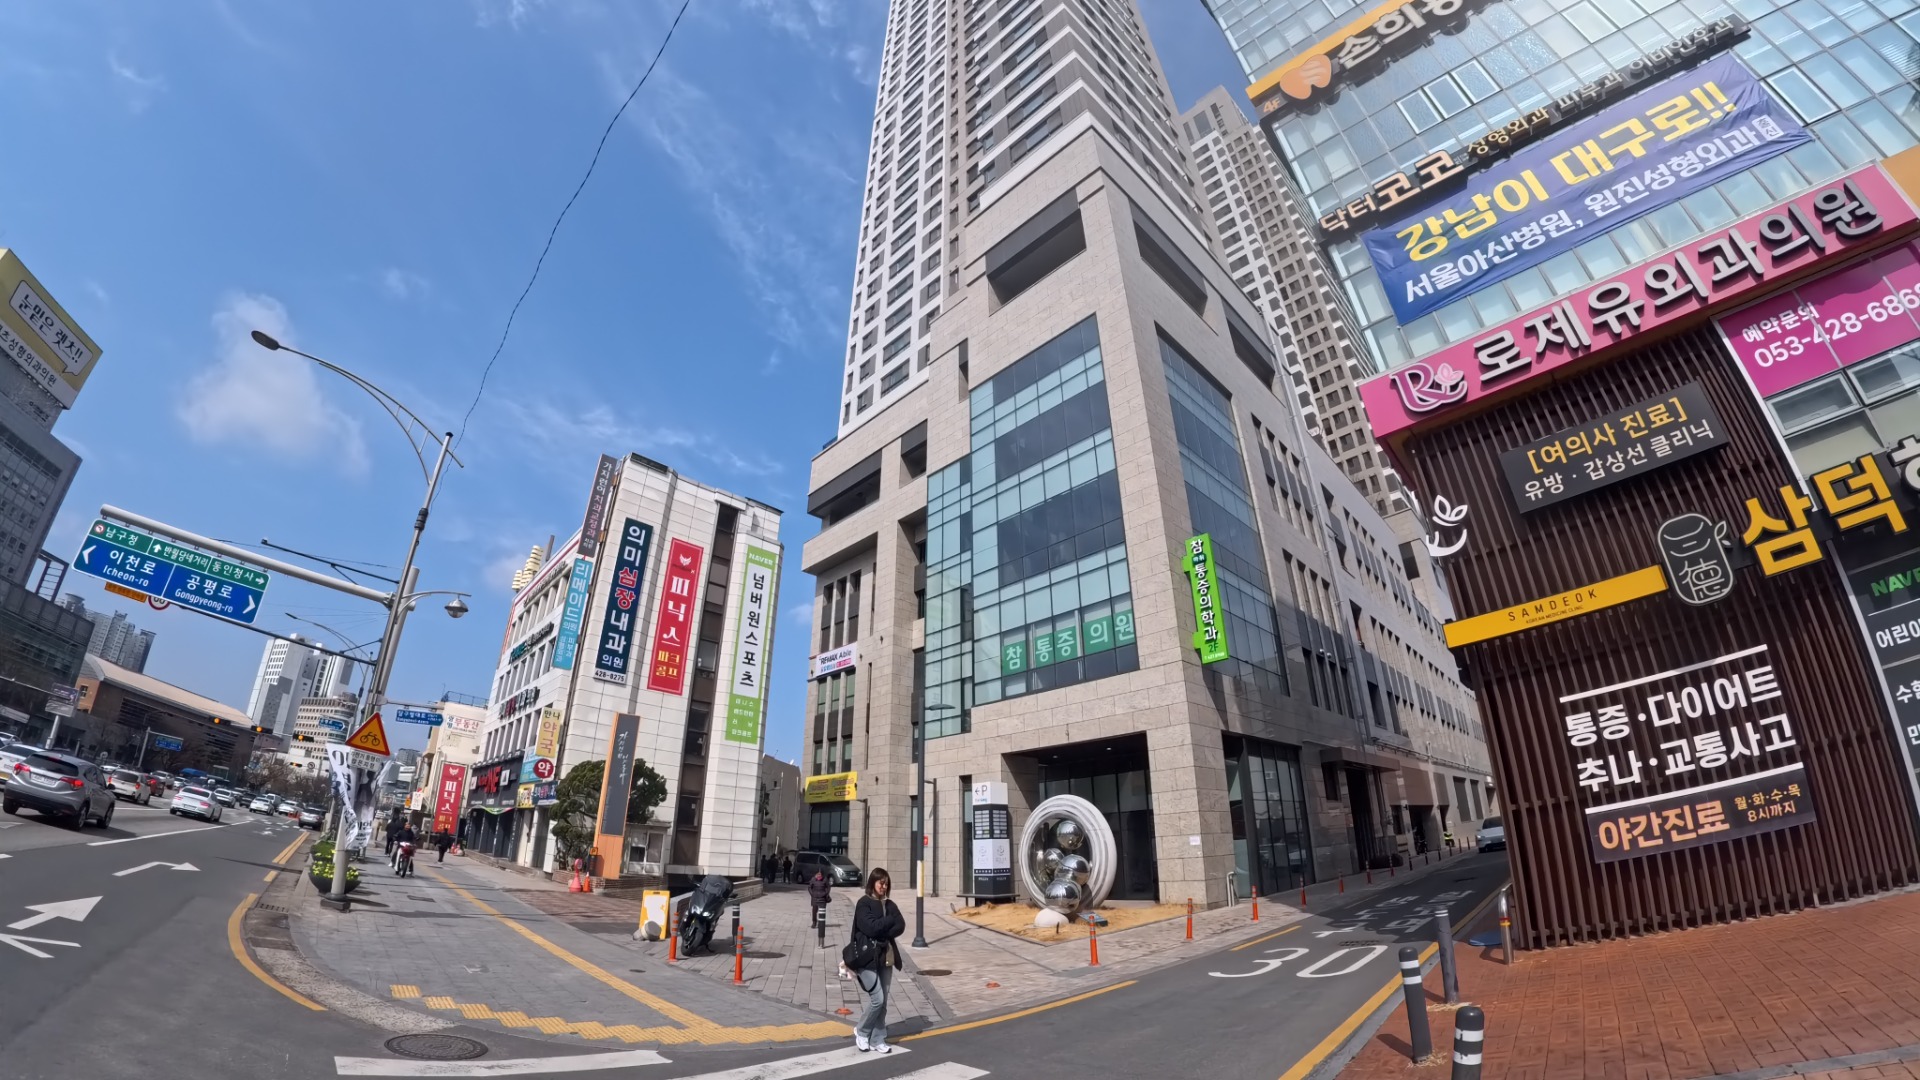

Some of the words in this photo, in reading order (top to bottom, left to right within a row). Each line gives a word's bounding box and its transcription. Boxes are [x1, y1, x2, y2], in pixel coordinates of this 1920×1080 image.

[1263, 97, 1280, 114] 4F
[1318, 150, 1465, 233] 닥터코코
[1465, 106, 1551, 156] 성형외과
[1555, 71, 1624, 111] 피부과
[1628, 17, 1737, 74] 이비인후과
[1396, 169, 1550, 262] 강남이
[1549, 81, 1738, 186] 대구로!!
[1584, 126, 1760, 217] 원진성형외과
[1473, 177, 1884, 386] 로제유외과의원
[18, 294, 55, 337] 눈밑은
[1742, 302, 1820, 343] 예약문의
[1527, 422, 1618, 475] [여의사
[1620, 396, 1688, 439] 진료]
[1524, 471, 1564, 501] 유방
[1583, 443, 1648, 481] 갑상선
[1650, 418, 1714, 458] 클리닉
[106, 526, 139, 546] 남구청
[1190, 538, 1203, 555] 참
[109, 549, 156, 576] 이천로
[164, 546, 208, 568] 반월당네거리
[211, 562, 255, 582] 동인청사
[103, 565, 149, 587] Icheon-ro
[187, 574, 233, 599] 공평로
[564, 562, 590, 622] 리메이드
[604, 524, 647, 654] 의미심장내과
[174, 588, 233, 614] Gongpyeong-ro
[661, 575, 690, 647] 피닉스
[1194, 562, 1218, 641] 통증의학과
[1508, 588, 1598, 622] SAMDEOK
[739, 572, 766, 687] 넘버원스포츠
[601, 654, 623, 669] 의원
[657, 650, 680, 665] 파크
[1006, 645, 1023, 671] 참
[1208, 642, 1219, 653] 2F
[655, 665, 678, 679] 골프
[455, 718, 479, 731] 부동산
[540, 721, 557, 754] 약국
[538, 762, 551, 777] 약
[440, 780, 457, 814] 피닉스
[1747, 800, 1796, 822] 8시까지
[1598, 800, 1730, 851] 야간진료
[1207, 944, 1389, 979] 30
